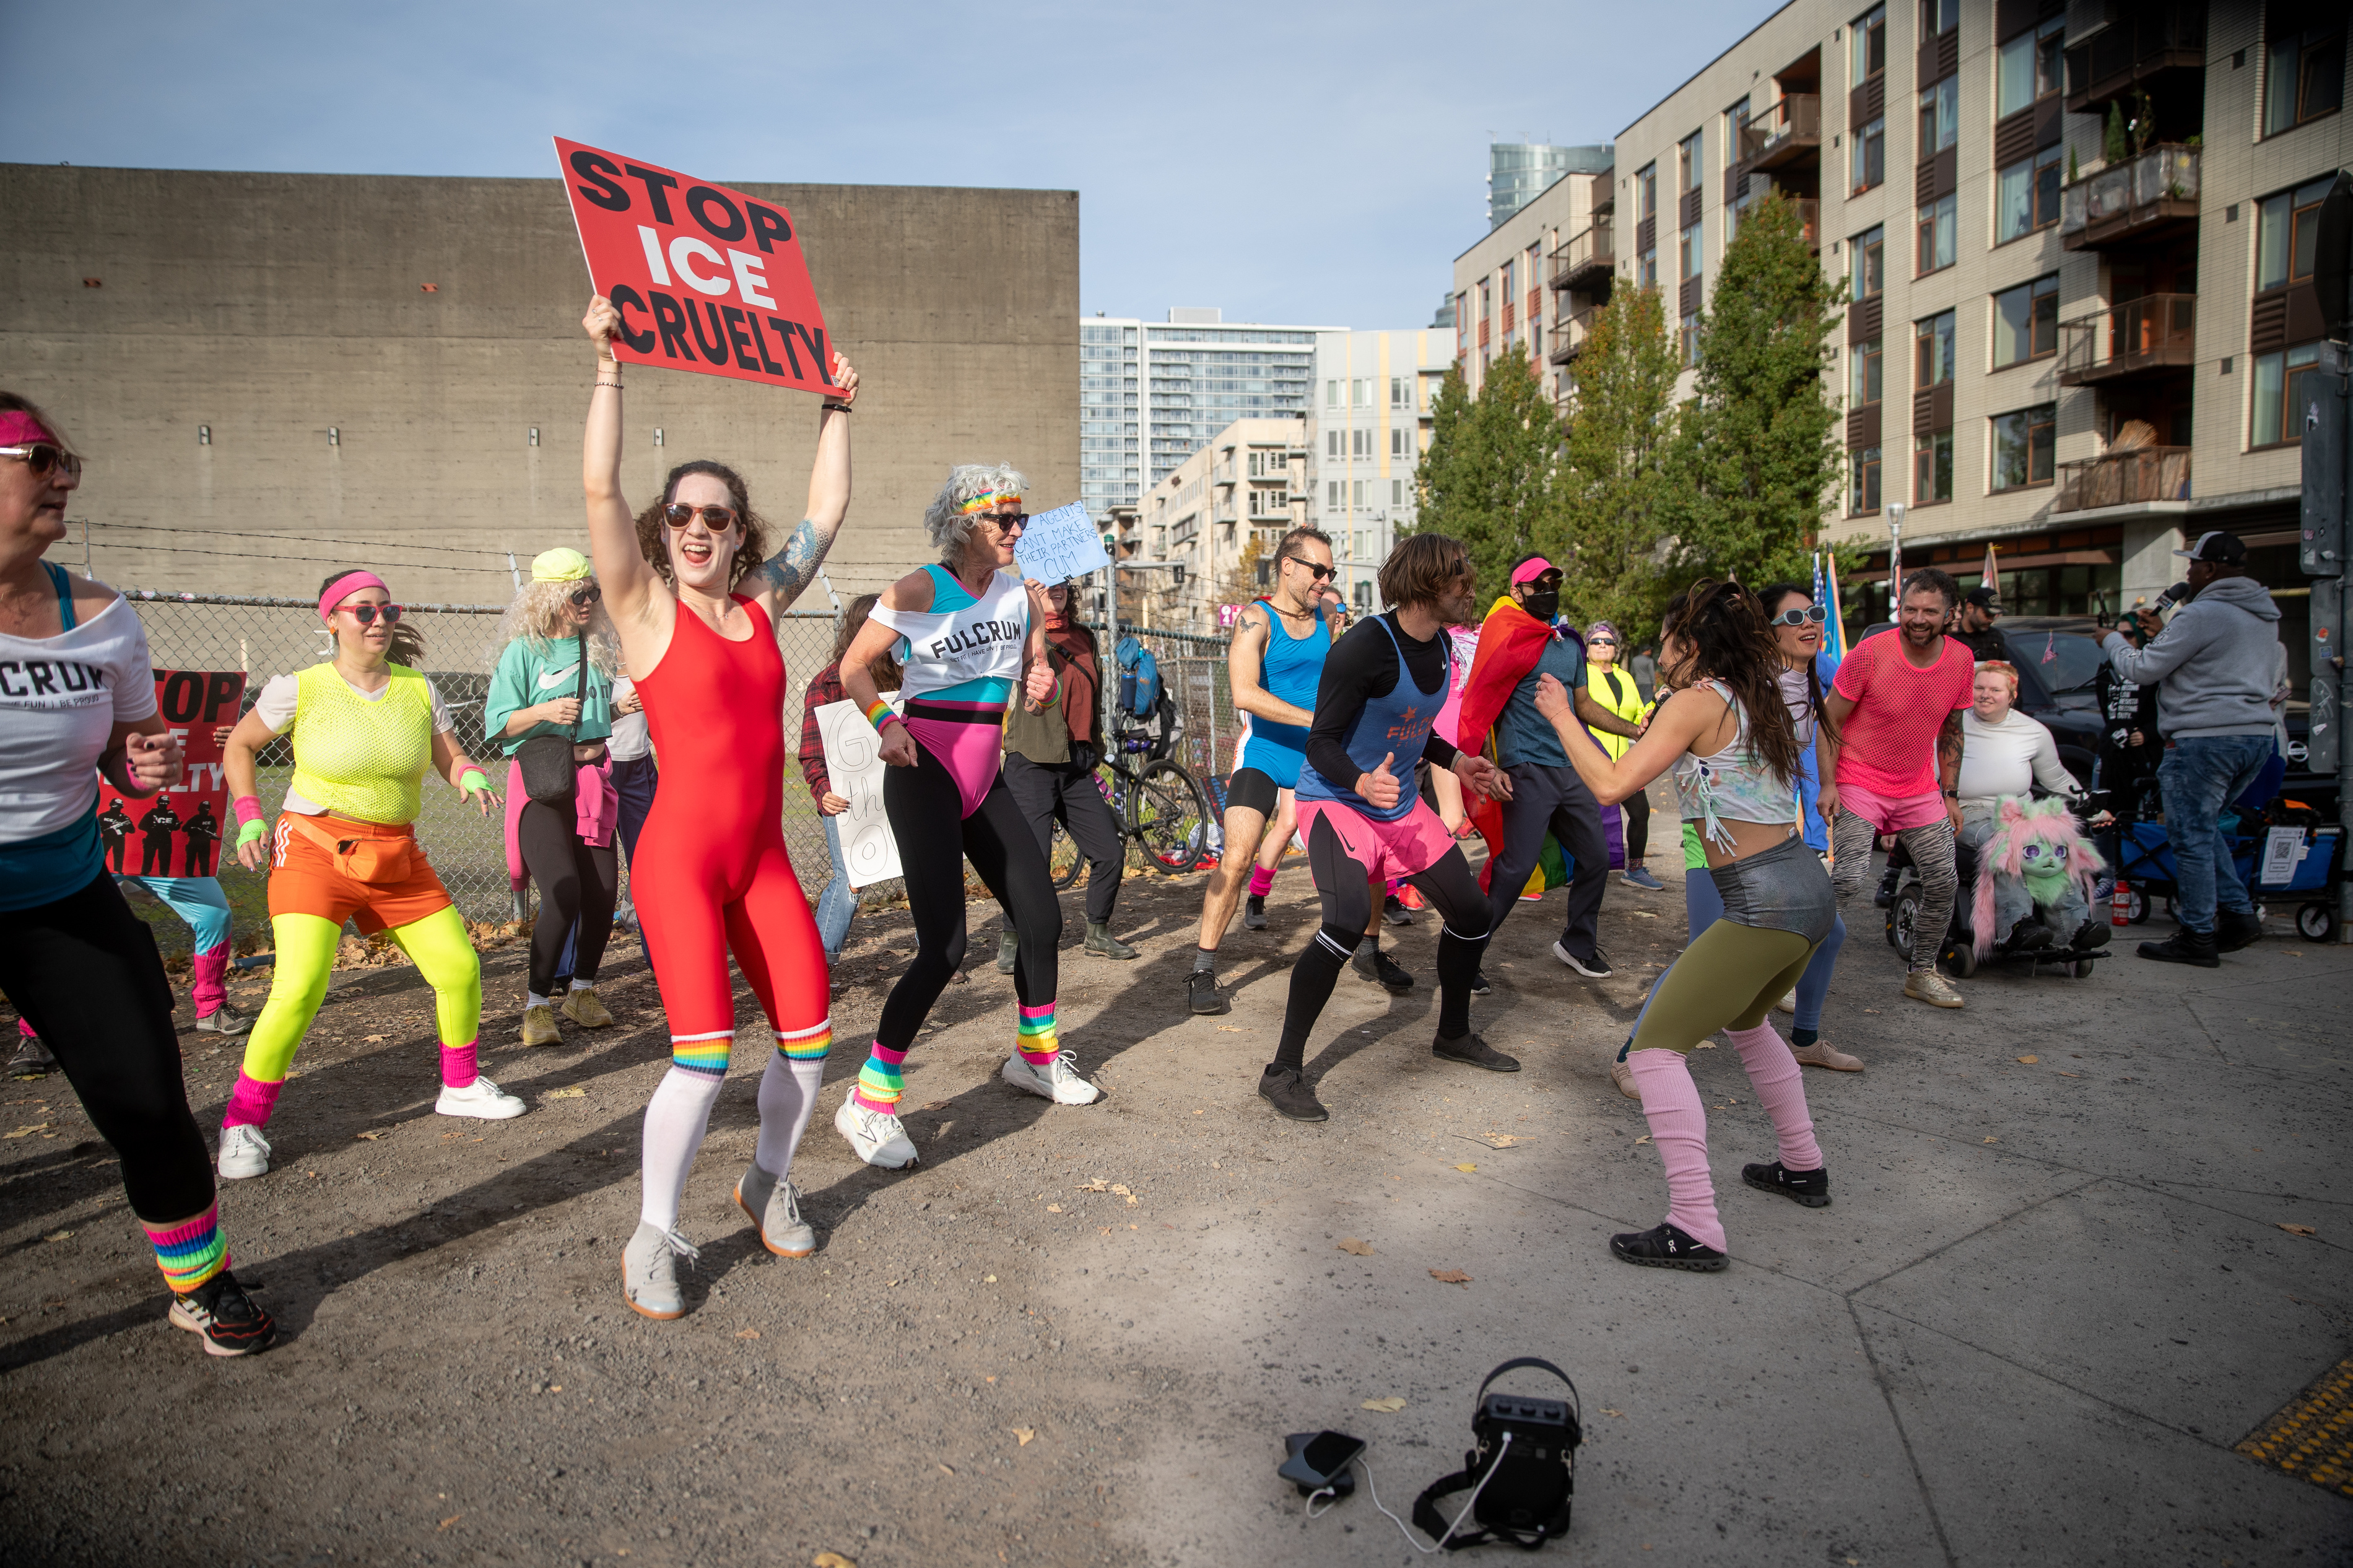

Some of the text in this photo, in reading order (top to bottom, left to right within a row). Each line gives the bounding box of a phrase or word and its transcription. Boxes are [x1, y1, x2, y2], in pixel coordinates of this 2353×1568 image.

[570, 150, 791, 255] STOP
[637, 225, 777, 311] ICE
[610, 284, 832, 386] CRUELTY
[1014, 518, 1086, 554] CAN'T MAKE
[1017, 528, 1098, 564] THEIR PARTNERS
[1044, 551, 1081, 579] CUM
[931, 621, 1021, 659] FULCRUM
[59, 699, 73, 708] BE
